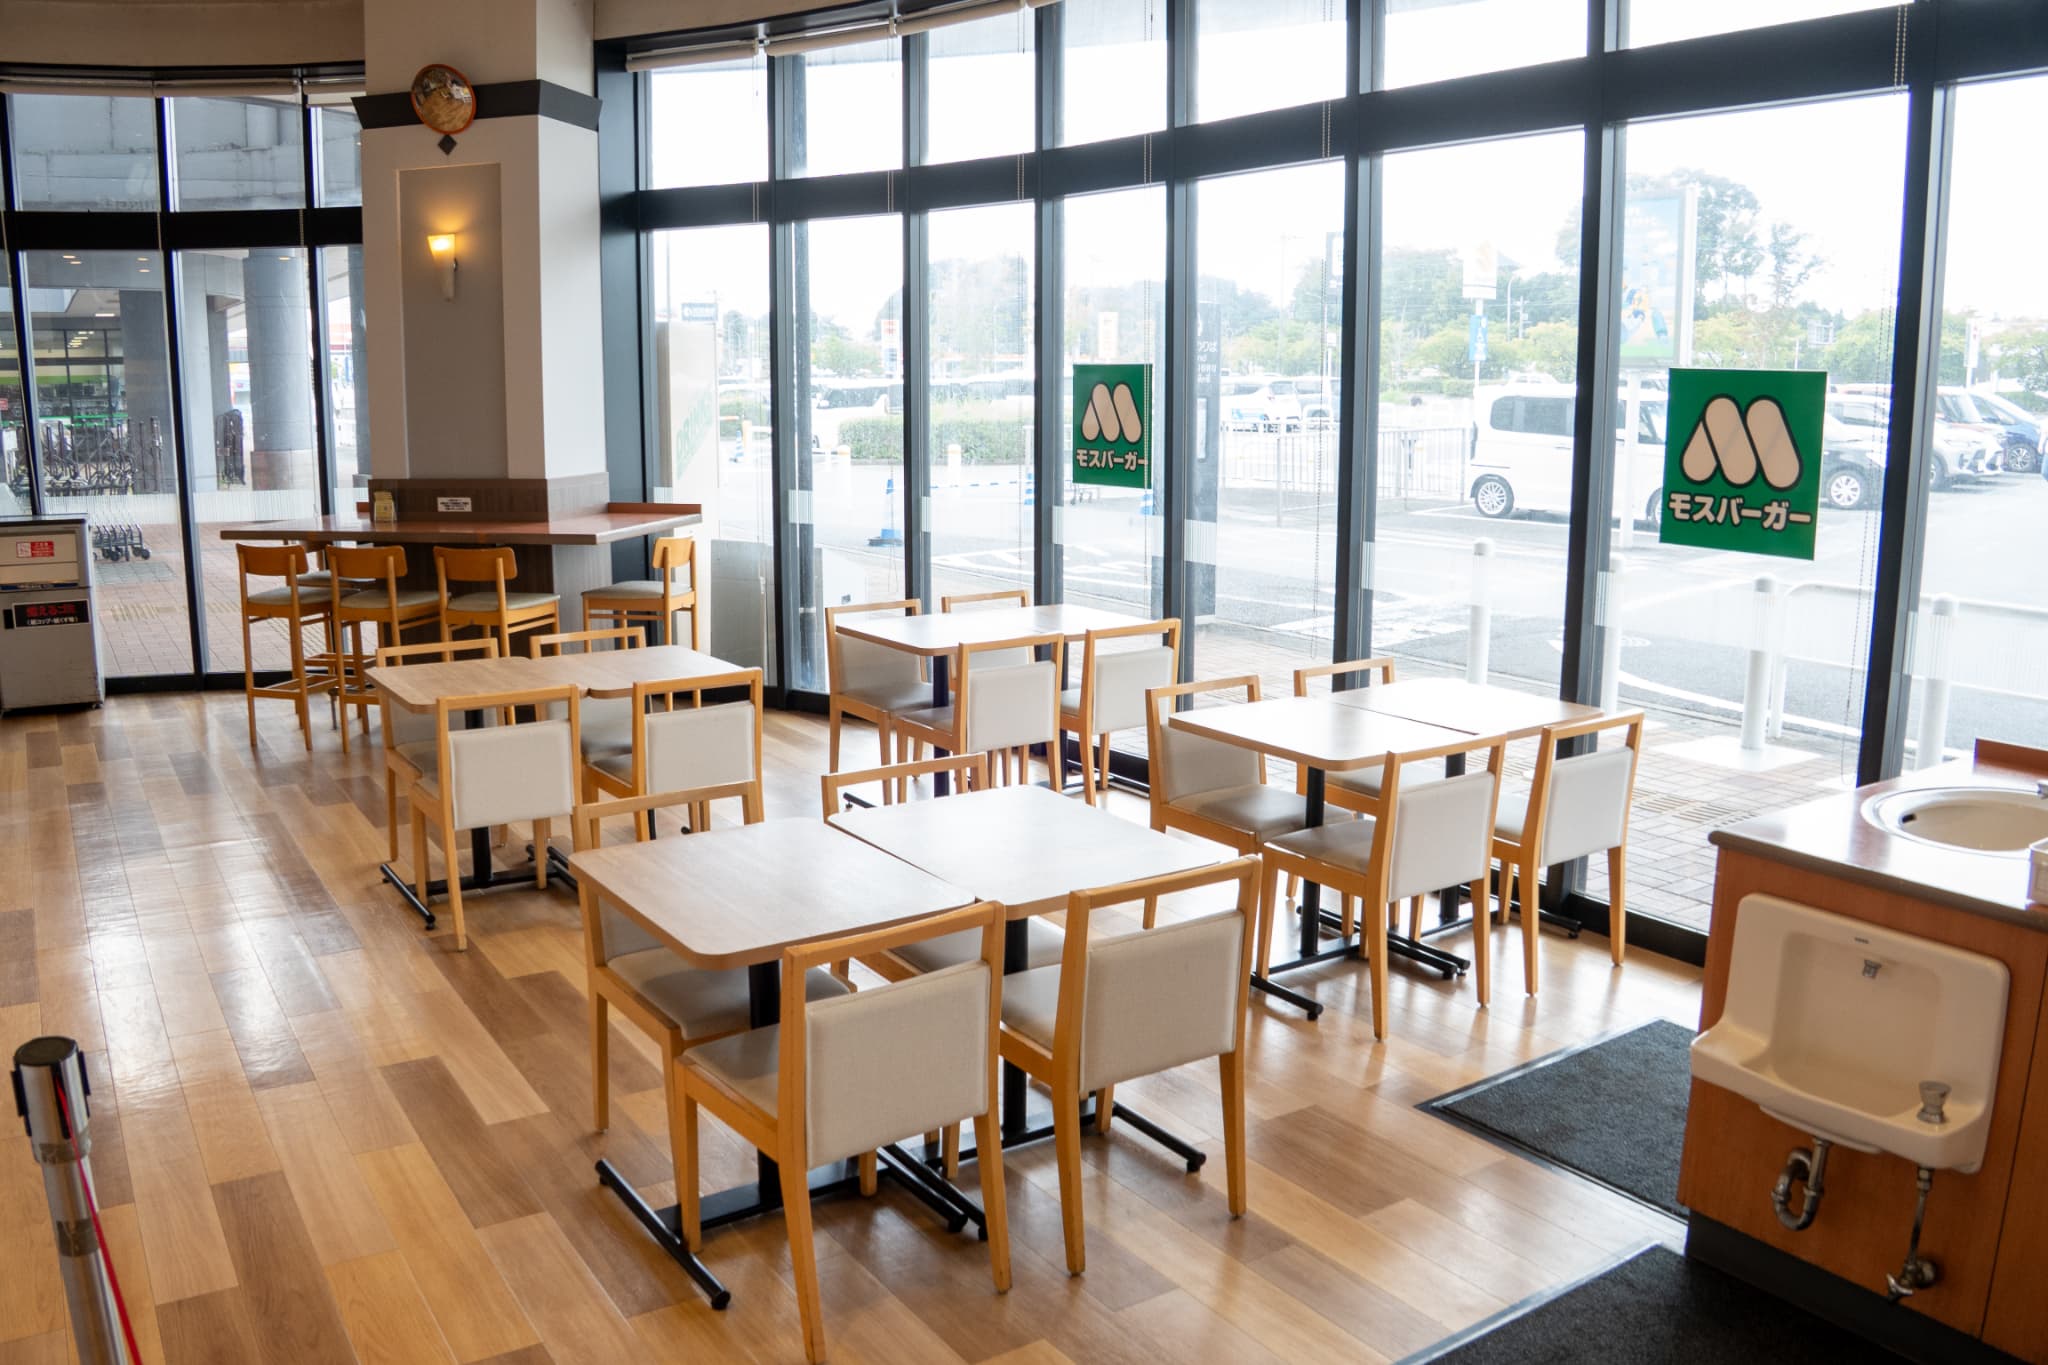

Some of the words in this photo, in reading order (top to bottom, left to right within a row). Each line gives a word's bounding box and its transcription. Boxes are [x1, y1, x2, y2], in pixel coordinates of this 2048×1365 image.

[1076, 448, 1148, 471] モスバーガー
[1668, 492, 1811, 531] モスバーガー
